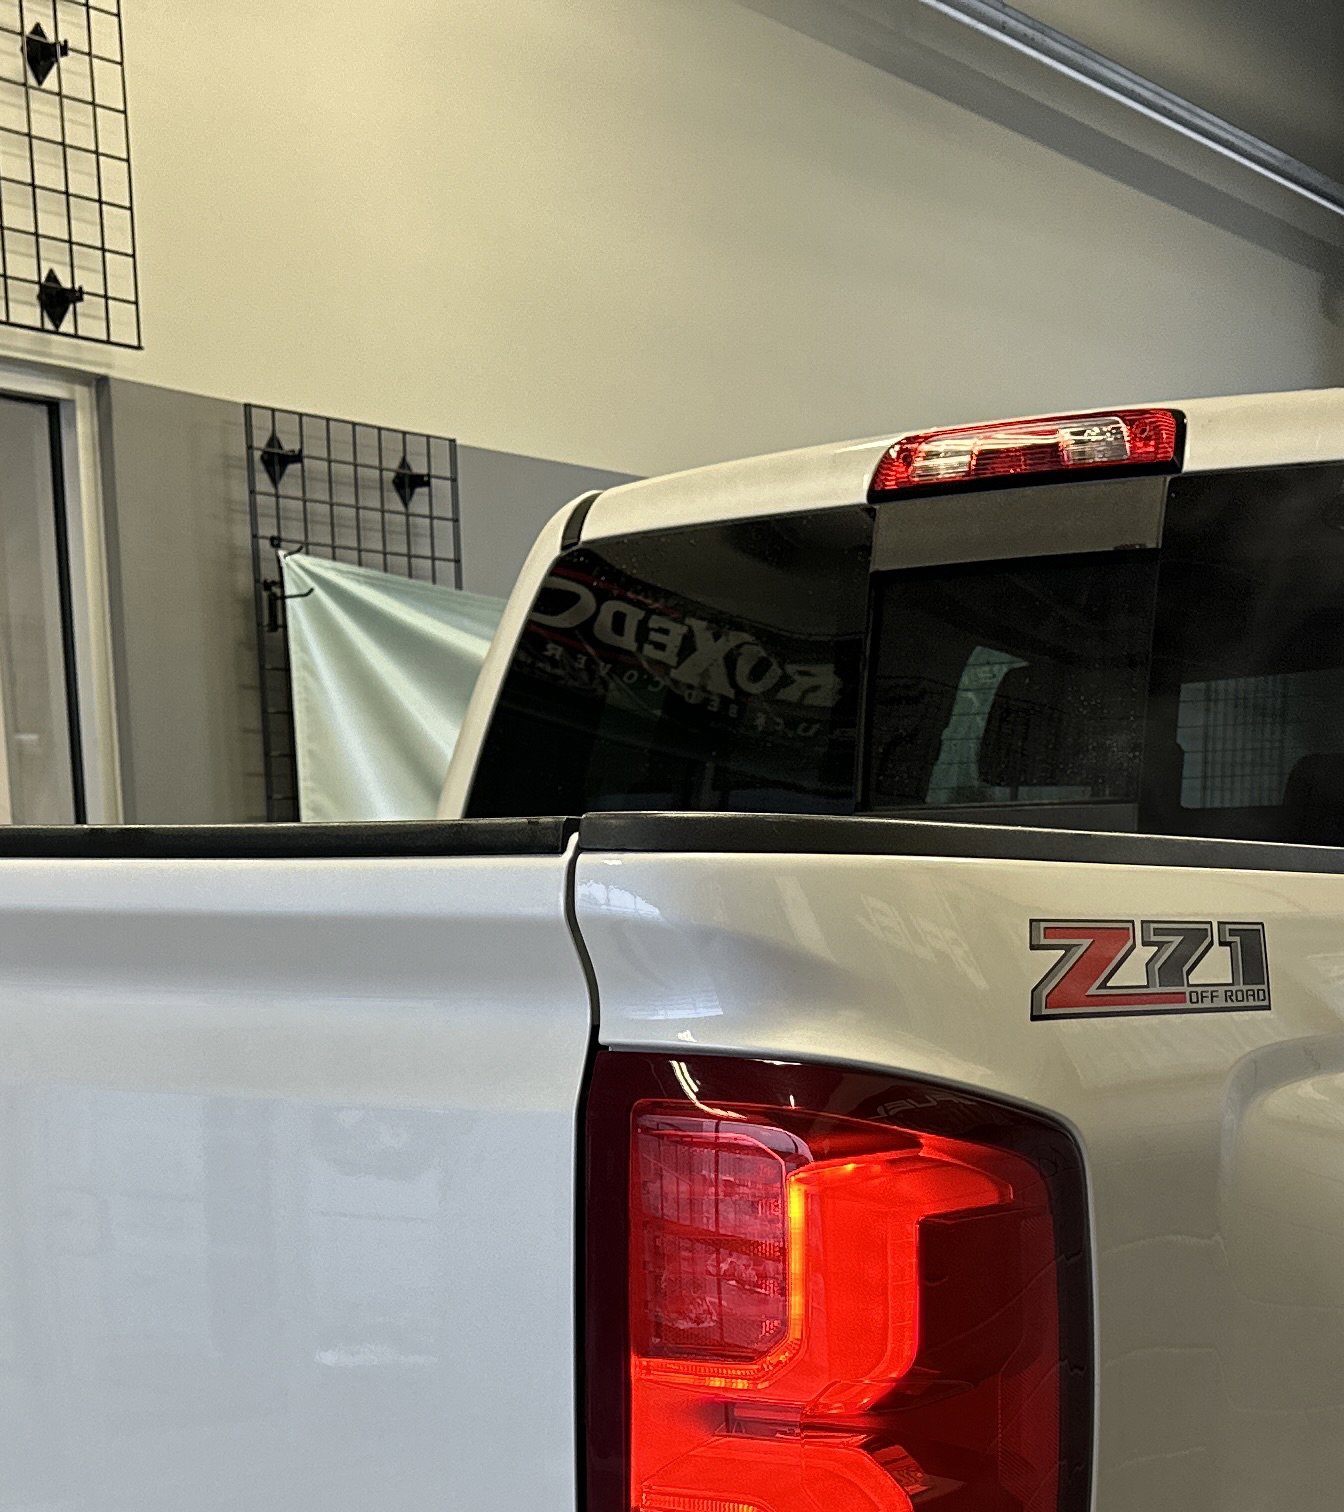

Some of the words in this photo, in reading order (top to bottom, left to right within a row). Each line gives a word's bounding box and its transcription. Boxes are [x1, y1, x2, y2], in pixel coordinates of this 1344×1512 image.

[1029, 919, 1271, 1021] Z71
[1189, 990, 1219, 1005] OFF
[1224, 988, 1267, 1004] ROAD
